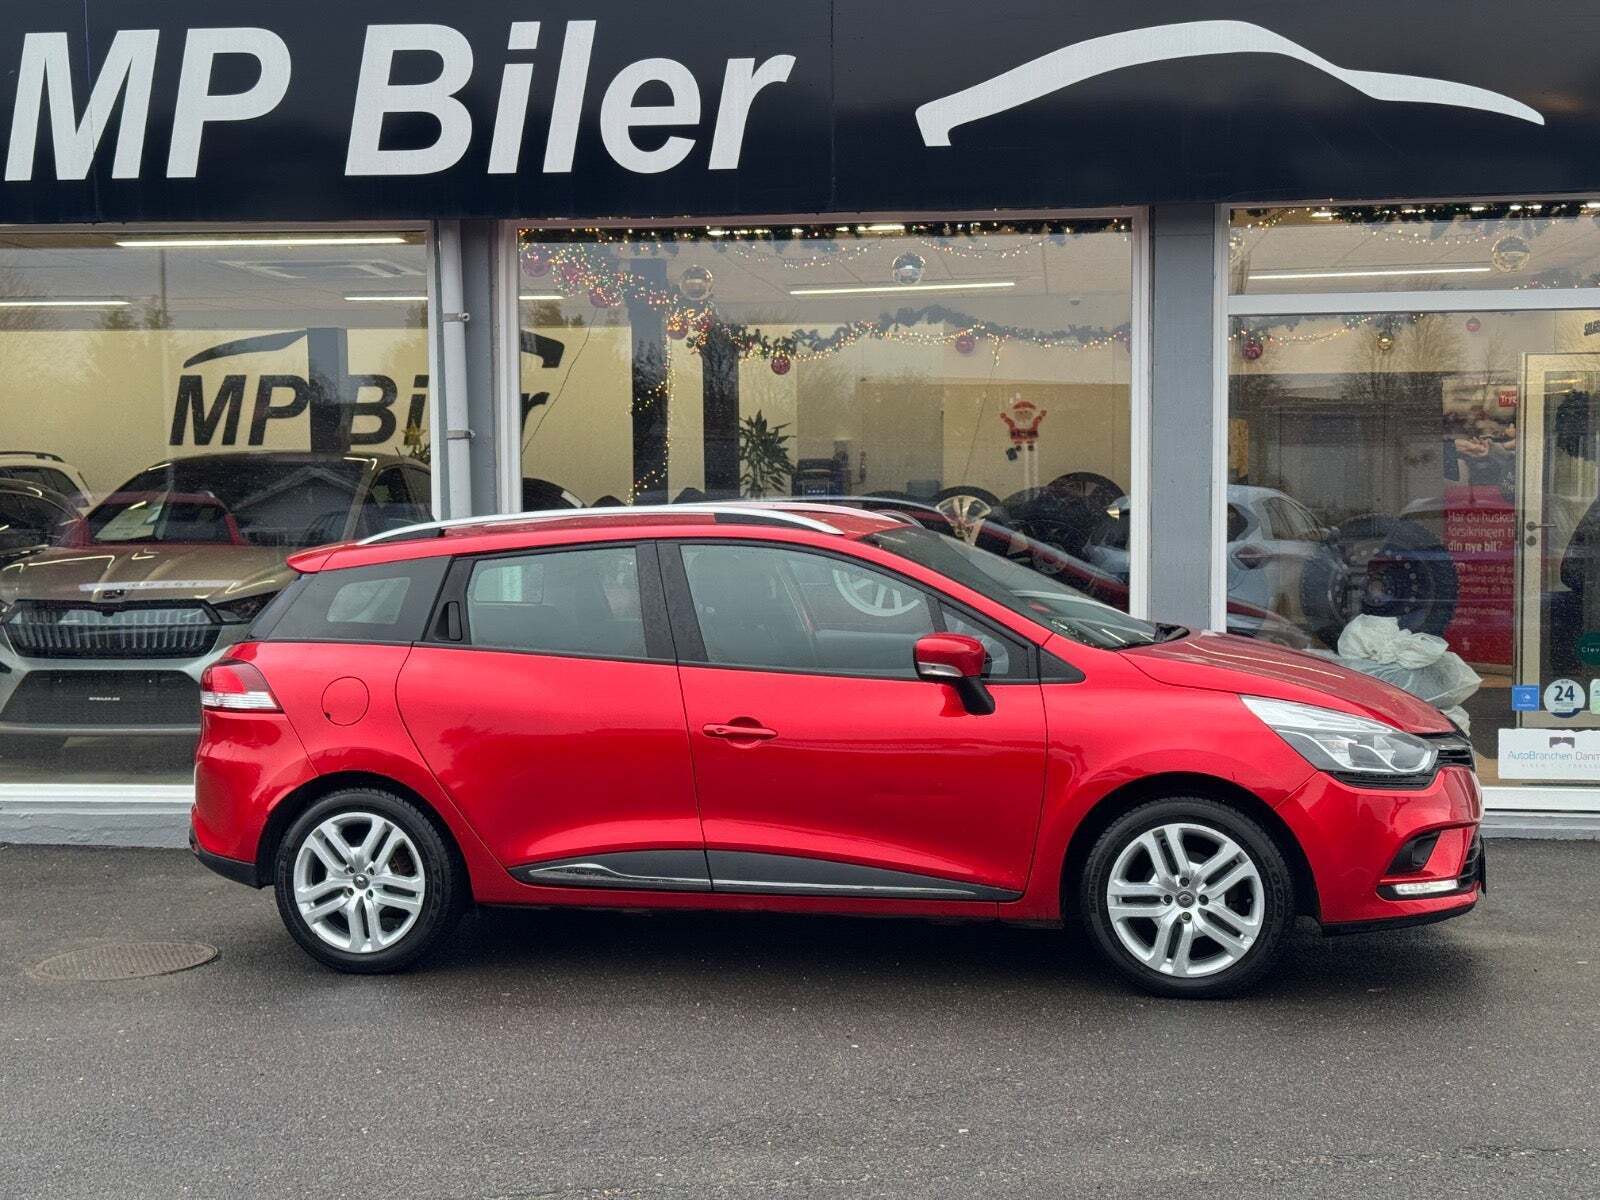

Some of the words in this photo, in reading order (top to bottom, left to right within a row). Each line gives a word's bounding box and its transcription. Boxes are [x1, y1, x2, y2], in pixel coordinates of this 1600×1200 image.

[4, 26, 292, 182] MP
[344, 19, 797, 177] Biler
[168, 374, 309, 446] MP
[1447, 540, 1464, 552] din
[1465, 543, 1482, 554] nye
[1484, 540, 1503, 552] bil?
[1553, 684, 1576, 702] 24
[1506, 750, 1573, 761] AutoBranchen
